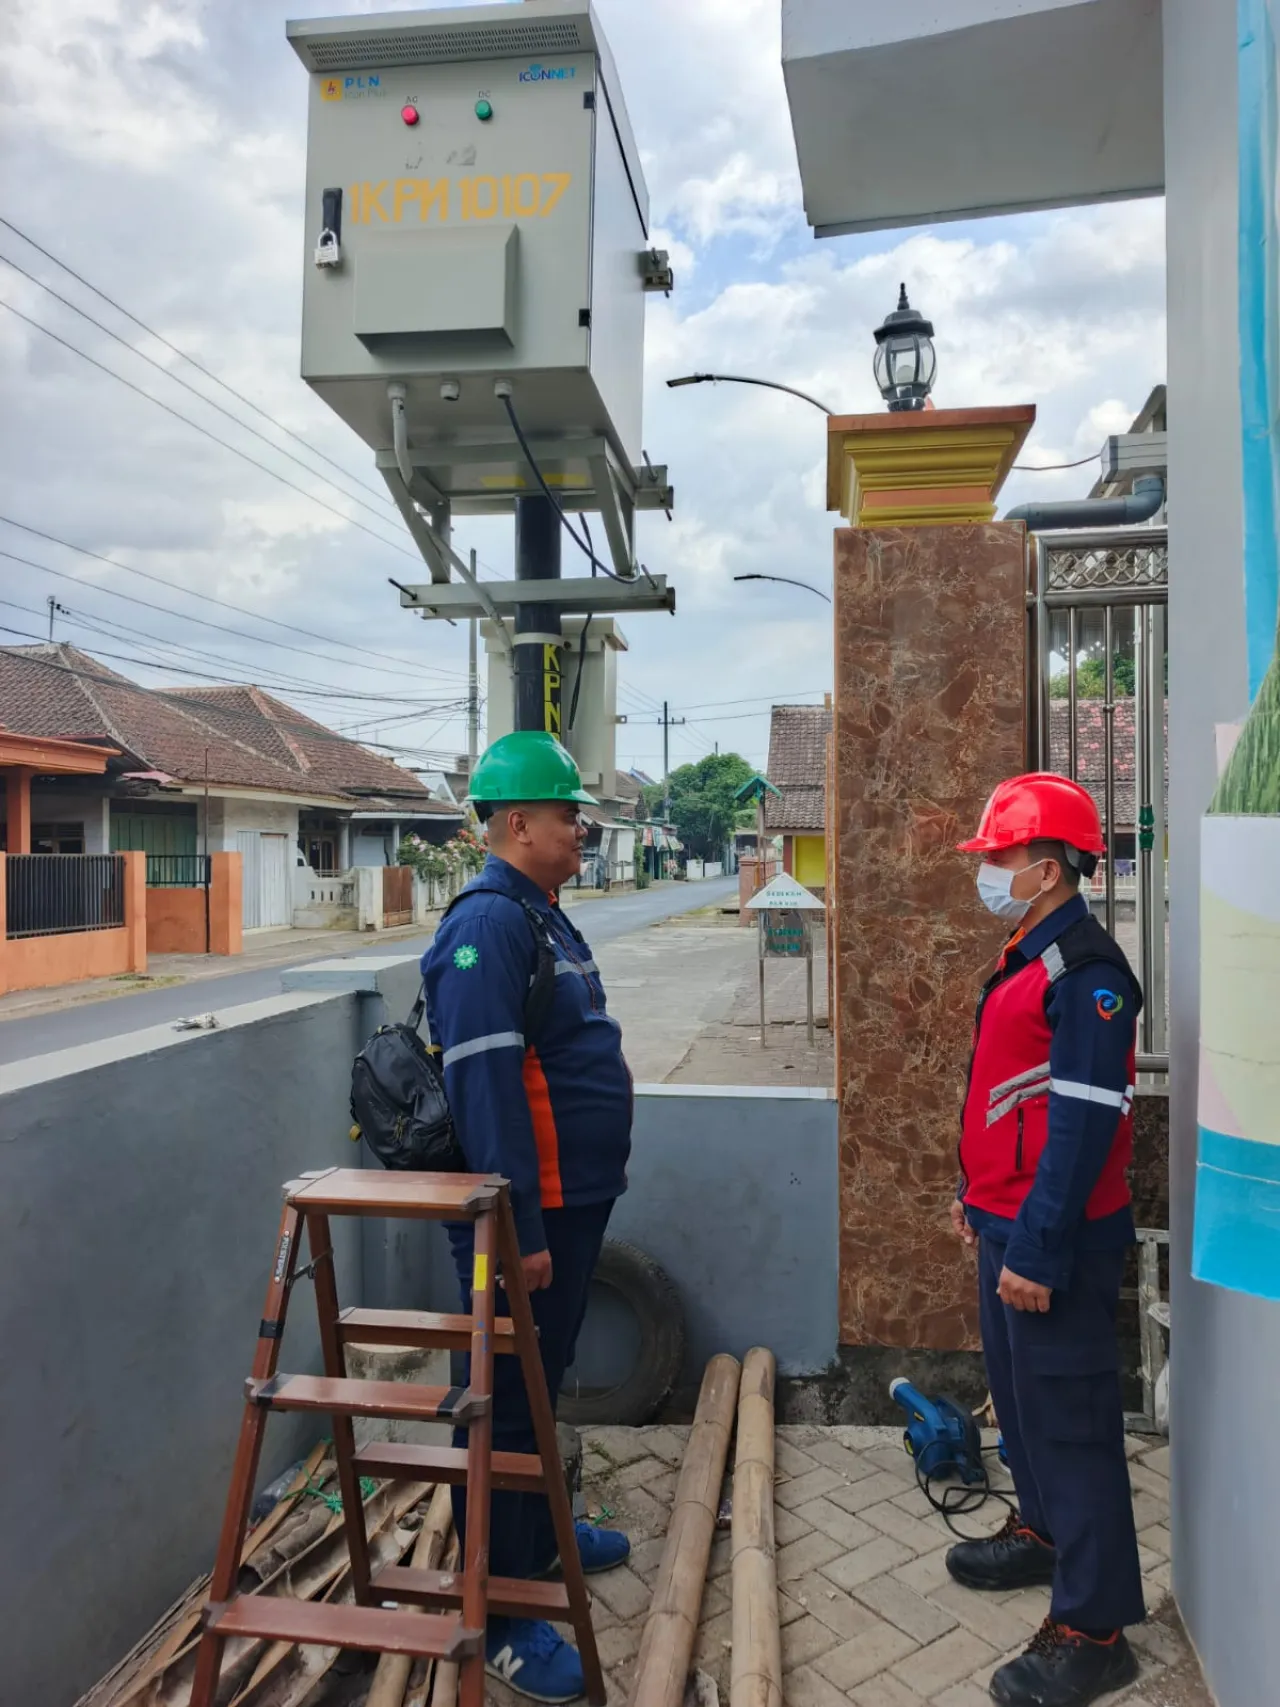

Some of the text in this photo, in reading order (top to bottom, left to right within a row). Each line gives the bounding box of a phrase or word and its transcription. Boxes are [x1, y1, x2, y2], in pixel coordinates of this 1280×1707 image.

[518, 66, 575, 82] ICONNET
[344, 76, 380, 89] PLN
[492, 1644, 524, 1680] N
